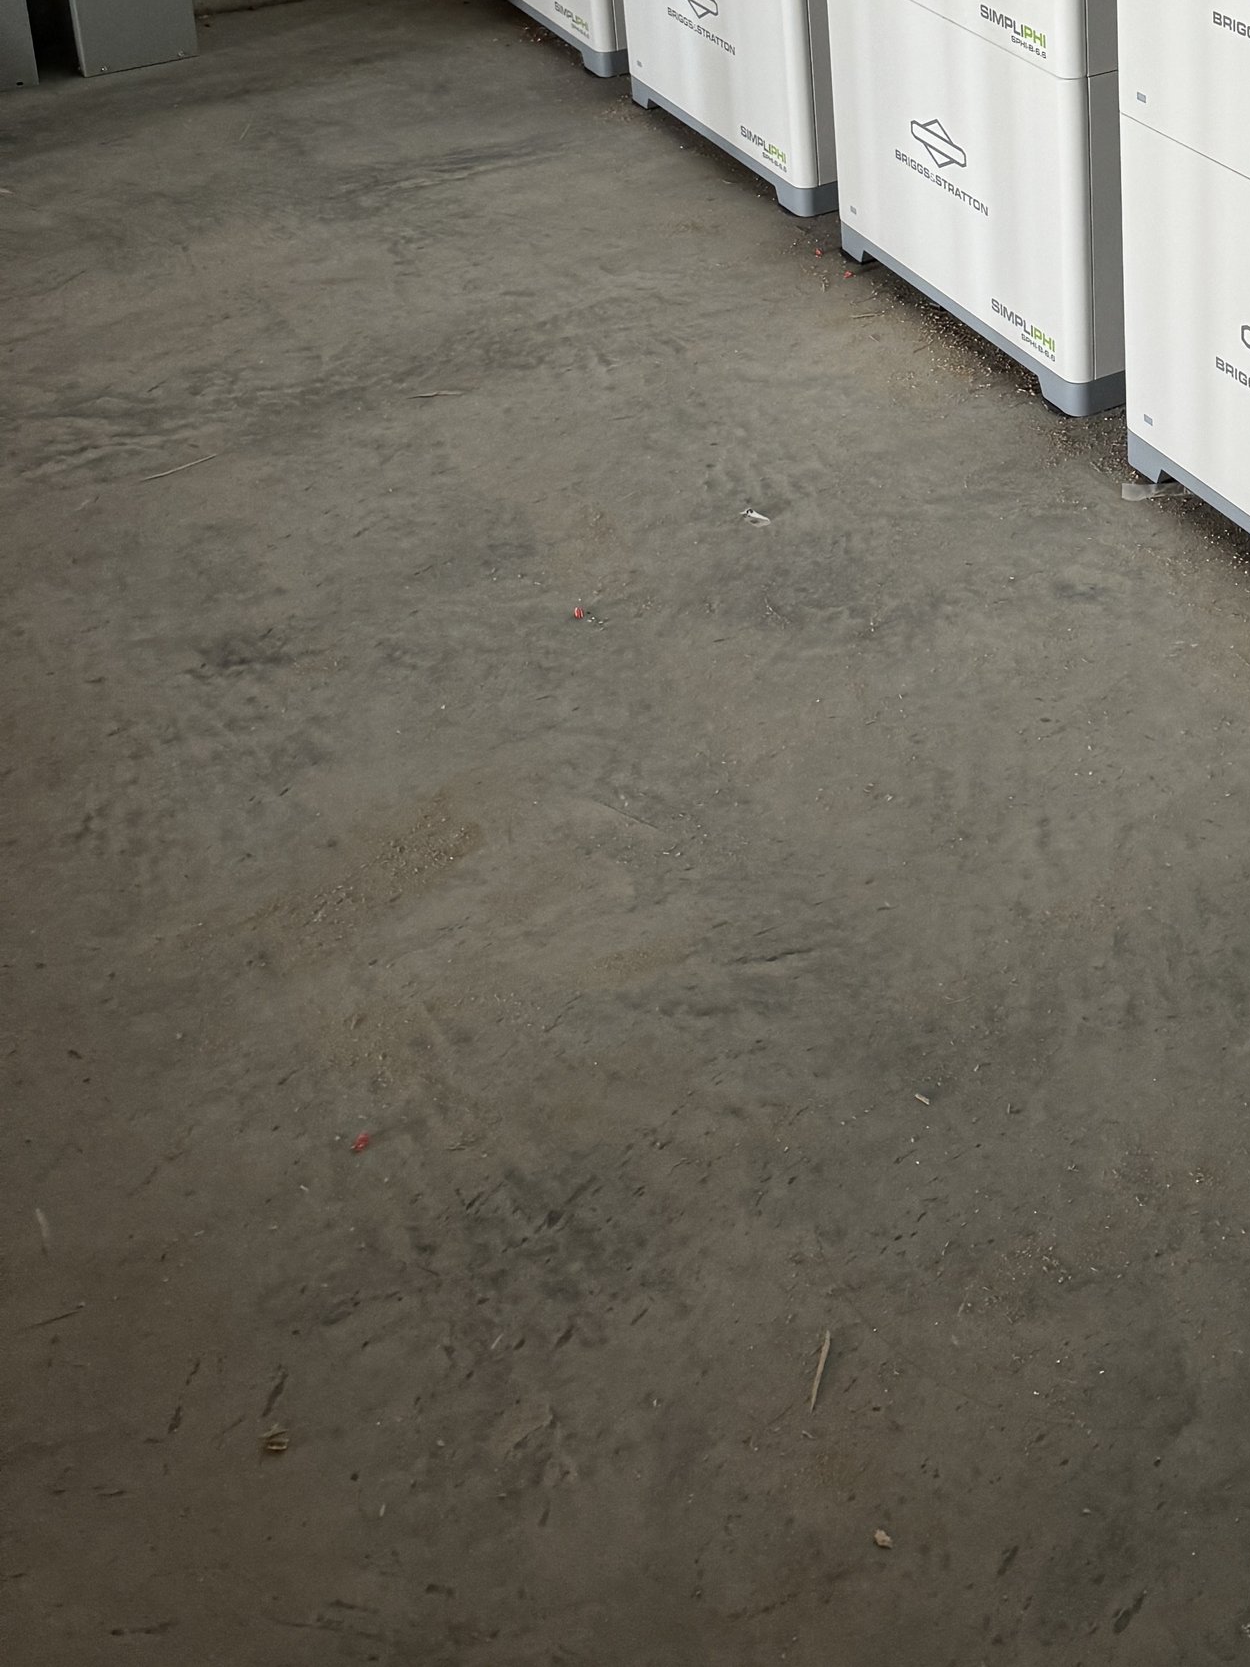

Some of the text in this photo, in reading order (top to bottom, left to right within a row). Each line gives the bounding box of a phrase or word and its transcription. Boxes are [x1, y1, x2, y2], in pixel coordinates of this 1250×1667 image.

[980, 2, 1046, 48] SIMPLIPHI
[740, 125, 787, 164] SIMPLIPHI
[991, 297, 1055, 353] SIMPLIPHI
